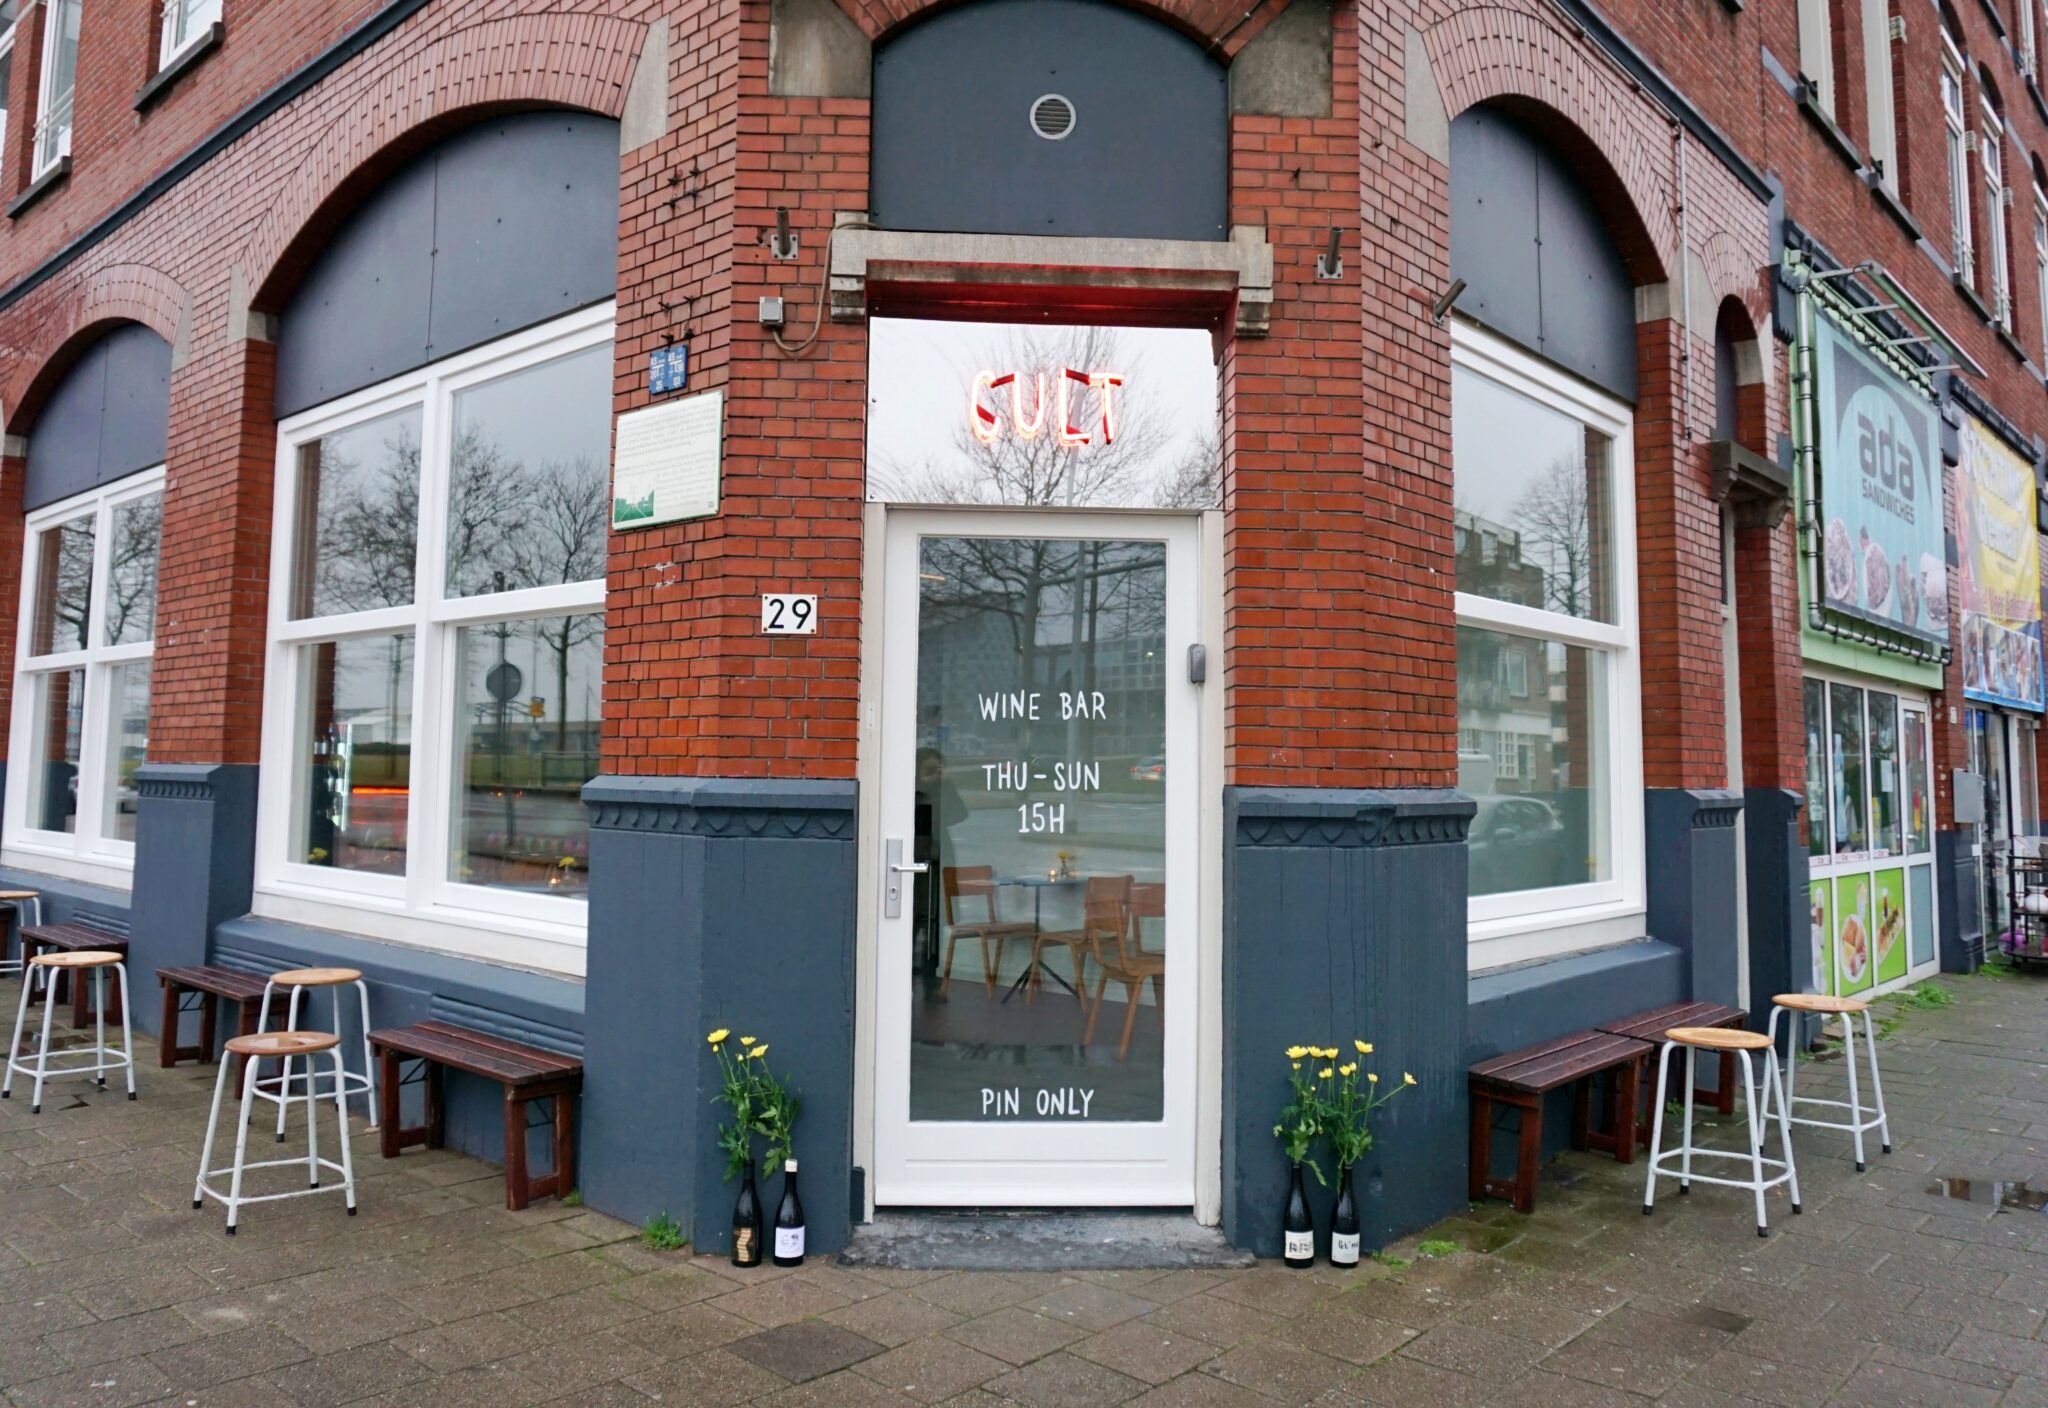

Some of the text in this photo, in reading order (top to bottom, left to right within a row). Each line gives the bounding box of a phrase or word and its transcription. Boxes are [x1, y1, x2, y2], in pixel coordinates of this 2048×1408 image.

[971, 367, 1125, 446] CULT
[1857, 411, 1915, 501] ada
[1862, 477, 1915, 526] SANDWICHES
[768, 598, 811, 630] 29
[978, 689, 1107, 722] WINE BAR
[1018, 802, 1065, 834] 15H
[981, 1086, 1095, 1118] PIN ONLY
